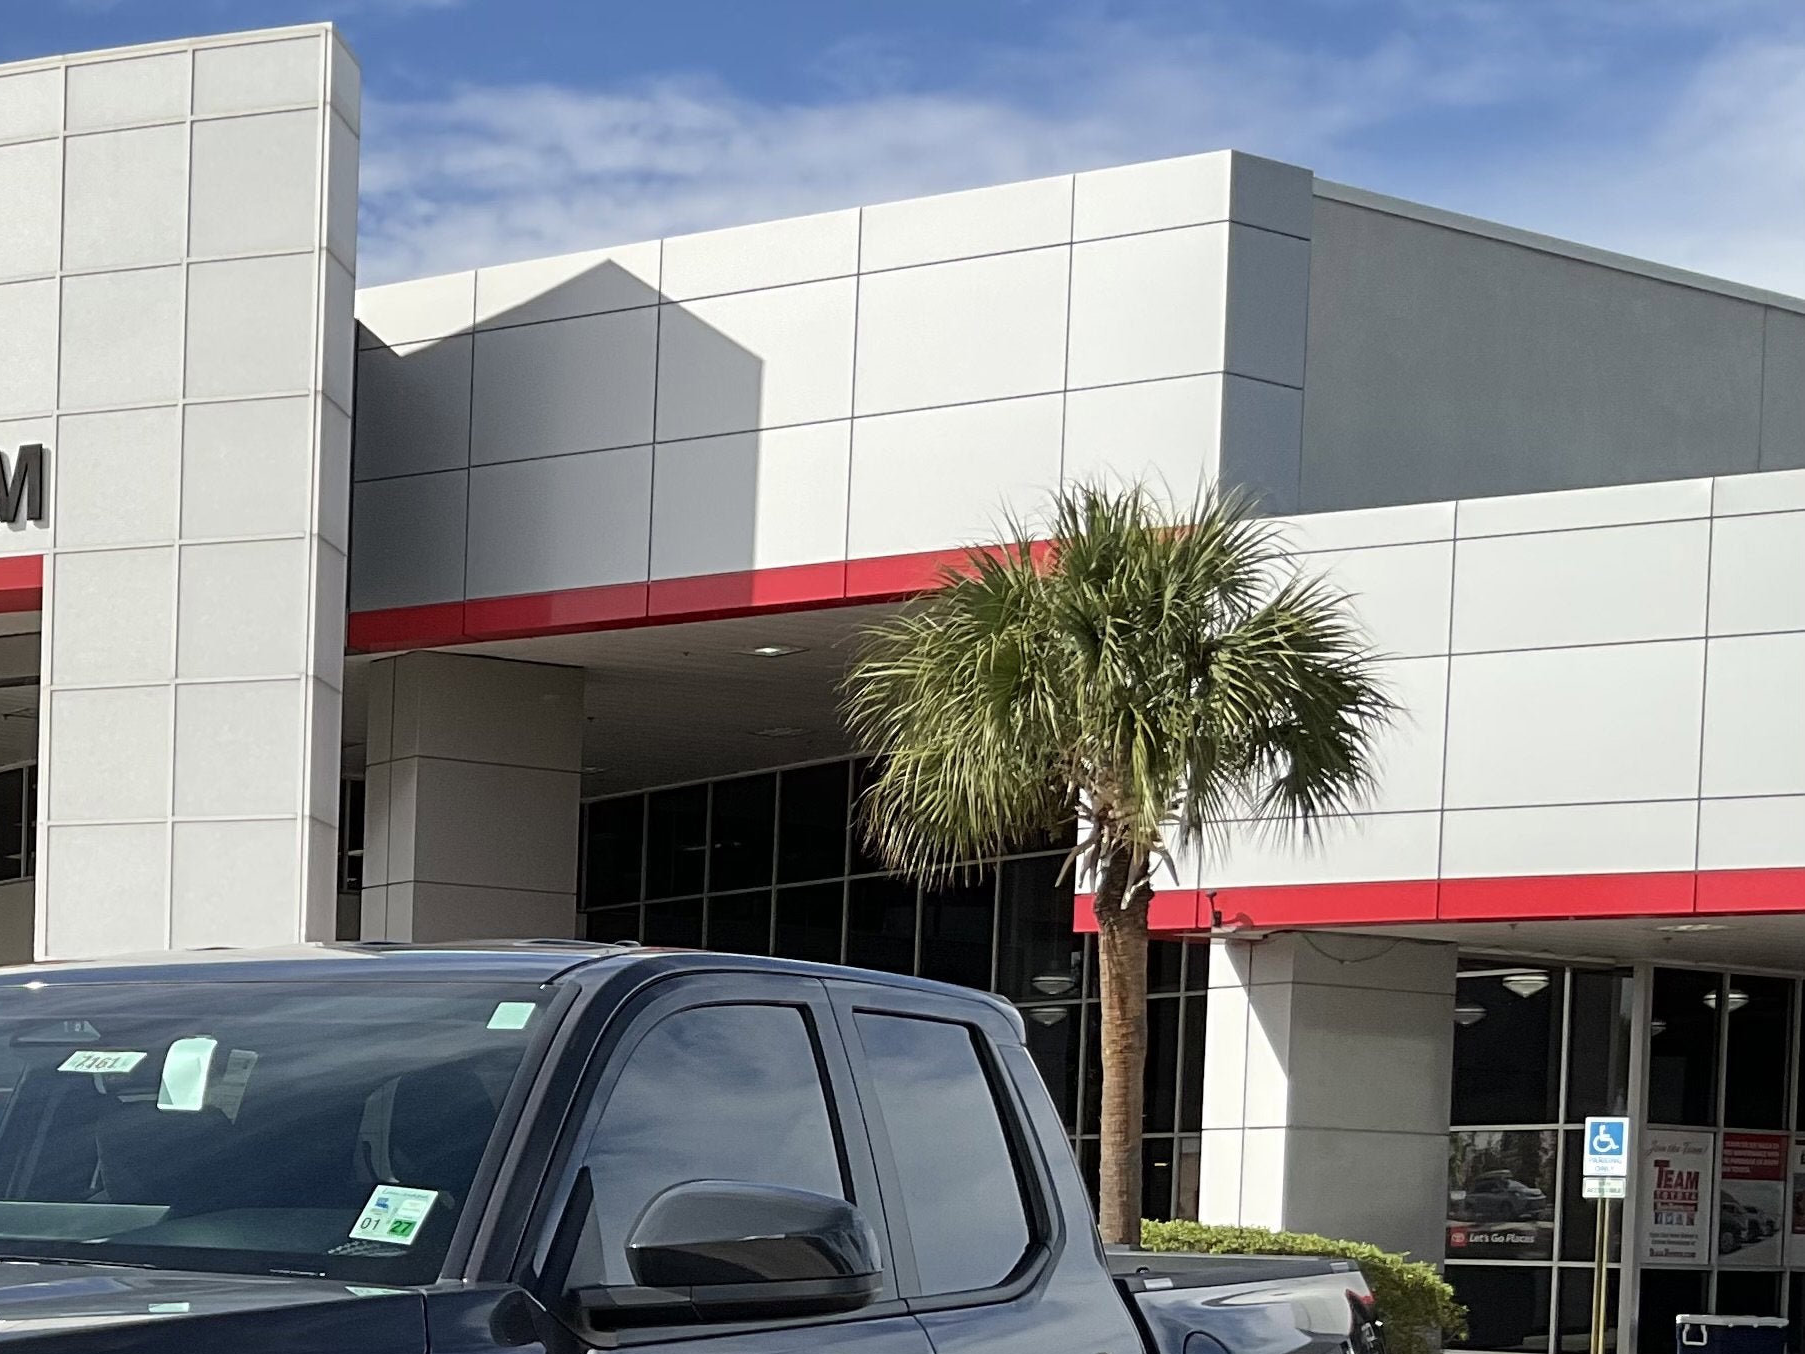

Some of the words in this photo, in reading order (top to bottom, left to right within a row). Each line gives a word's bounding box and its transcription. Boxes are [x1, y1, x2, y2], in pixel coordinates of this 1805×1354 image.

[360, 1217, 381, 1231] 01
[389, 1220, 414, 1234] 27
[1469, 1233, 1489, 1243] Let's
[1491, 1233, 1505, 1243] Go
[1506, 1233, 1535, 1243] Places
